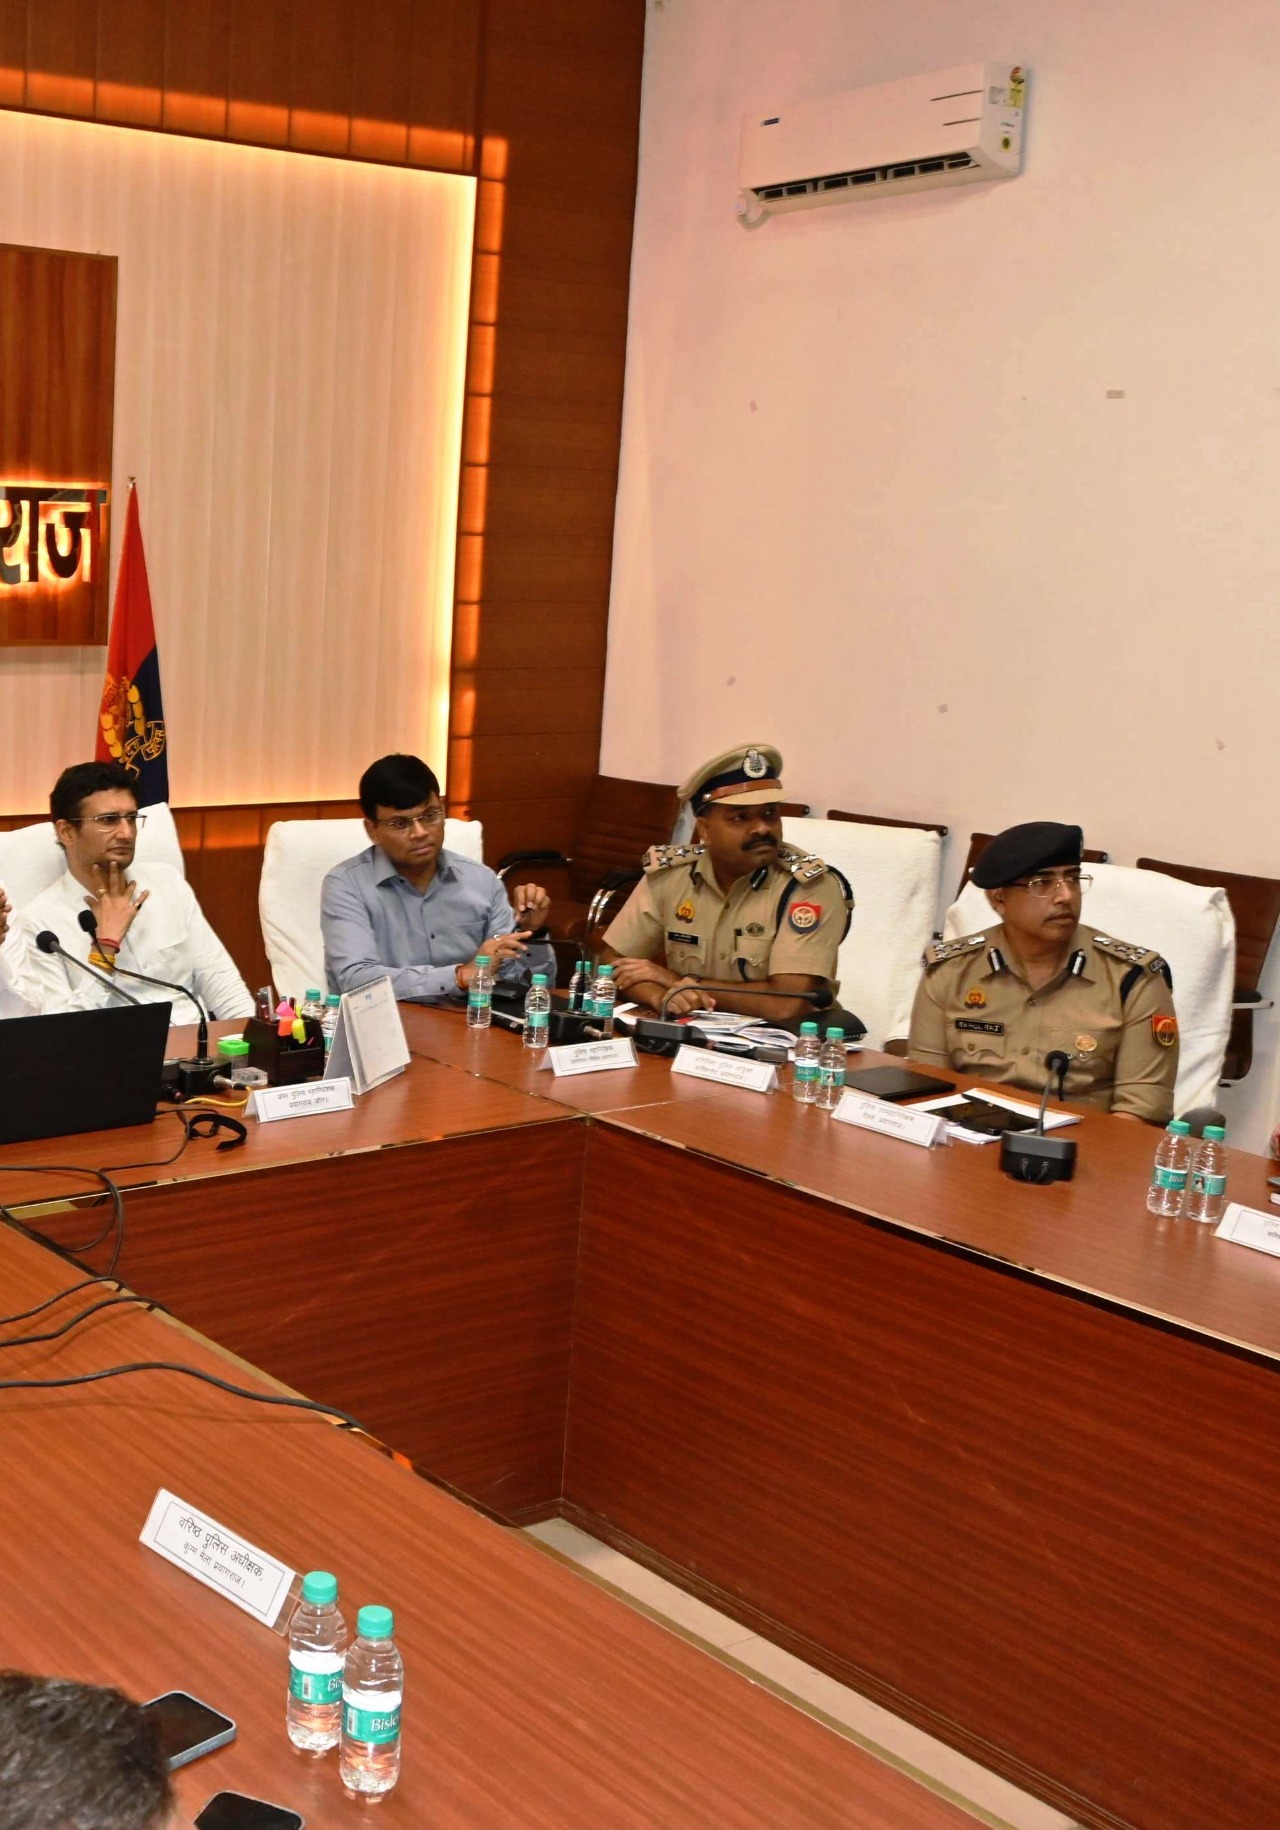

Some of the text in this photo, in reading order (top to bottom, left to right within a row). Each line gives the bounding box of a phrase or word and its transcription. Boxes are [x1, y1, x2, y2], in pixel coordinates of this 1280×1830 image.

[290, 1089, 306, 1100] पुलिस
[178, 1516, 202, 1538] वरिष्ठ
[202, 1532, 230, 1556] पुलिस
[183, 1541, 198, 1556] कुम्भ
[199, 1550, 213, 1566] मेला
